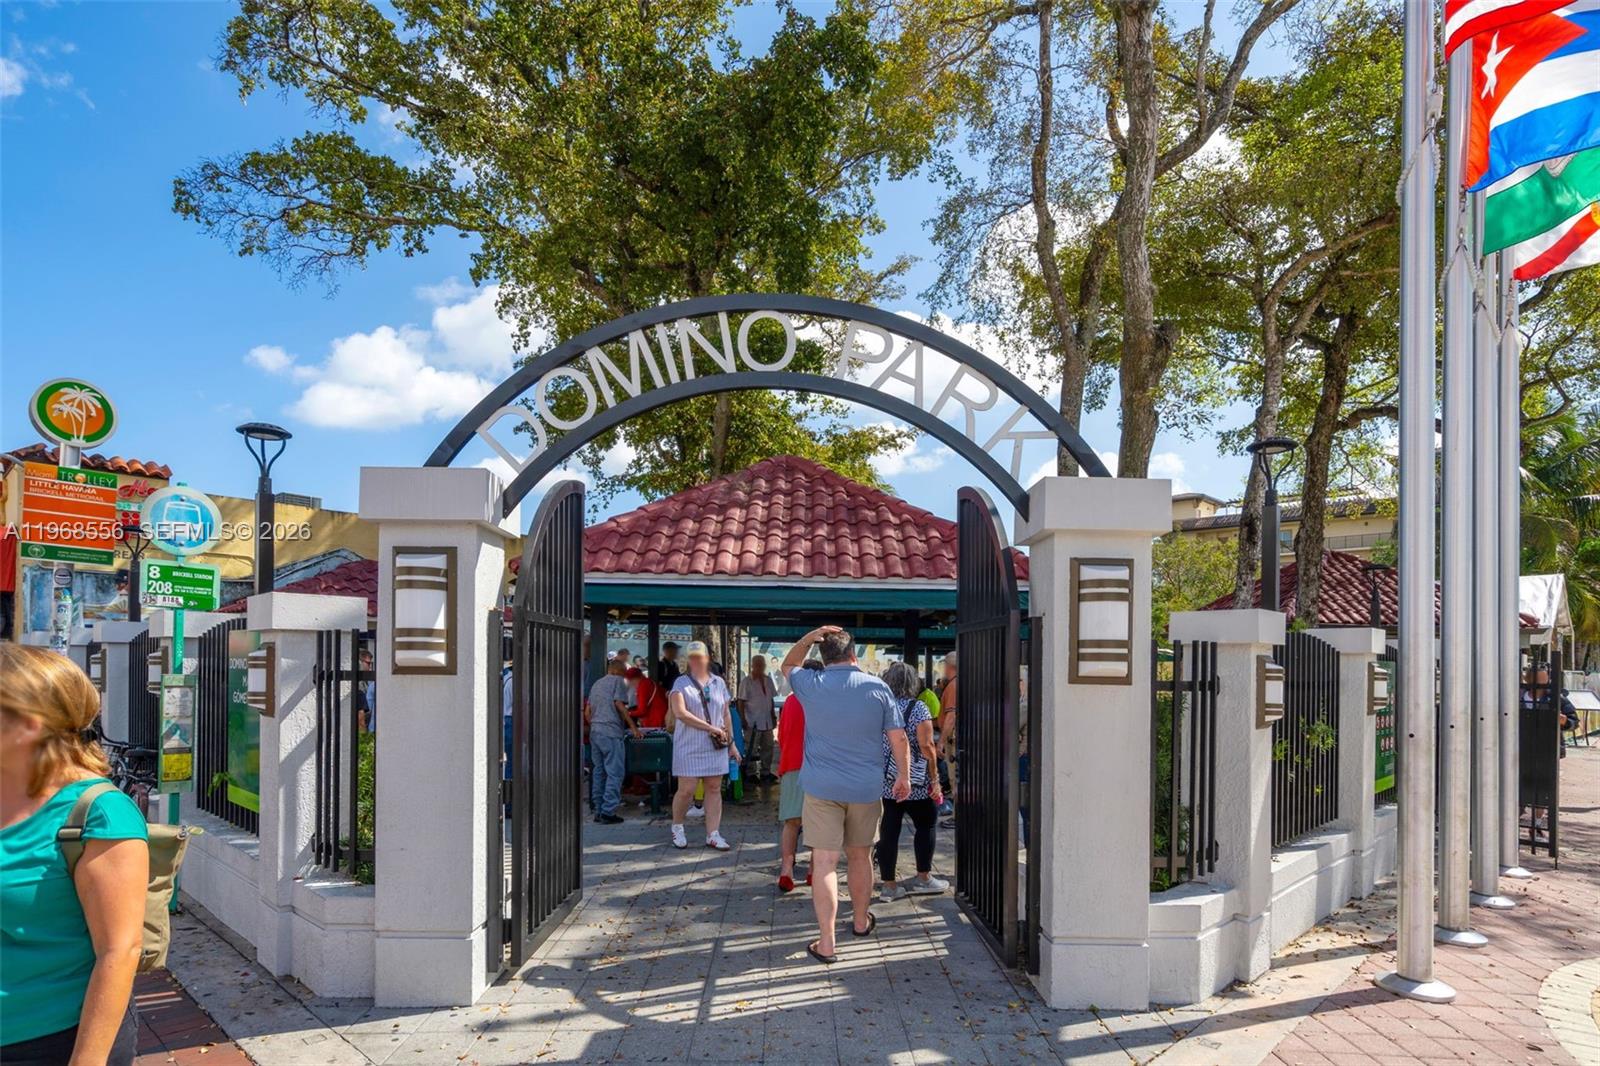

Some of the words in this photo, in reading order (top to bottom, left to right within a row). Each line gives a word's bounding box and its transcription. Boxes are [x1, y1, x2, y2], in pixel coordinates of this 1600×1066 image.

[477, 309, 797, 474] DOMINO
[834, 319, 1058, 482] PARK
[60, 470, 114, 487] TROLLEY
[29, 480, 60, 490] LITTLE
[61, 484, 97, 495] HAVANA
[29, 488, 63, 496] BRICKELL
[148, 565, 161, 579] 8
[148, 580, 173, 595] 208
